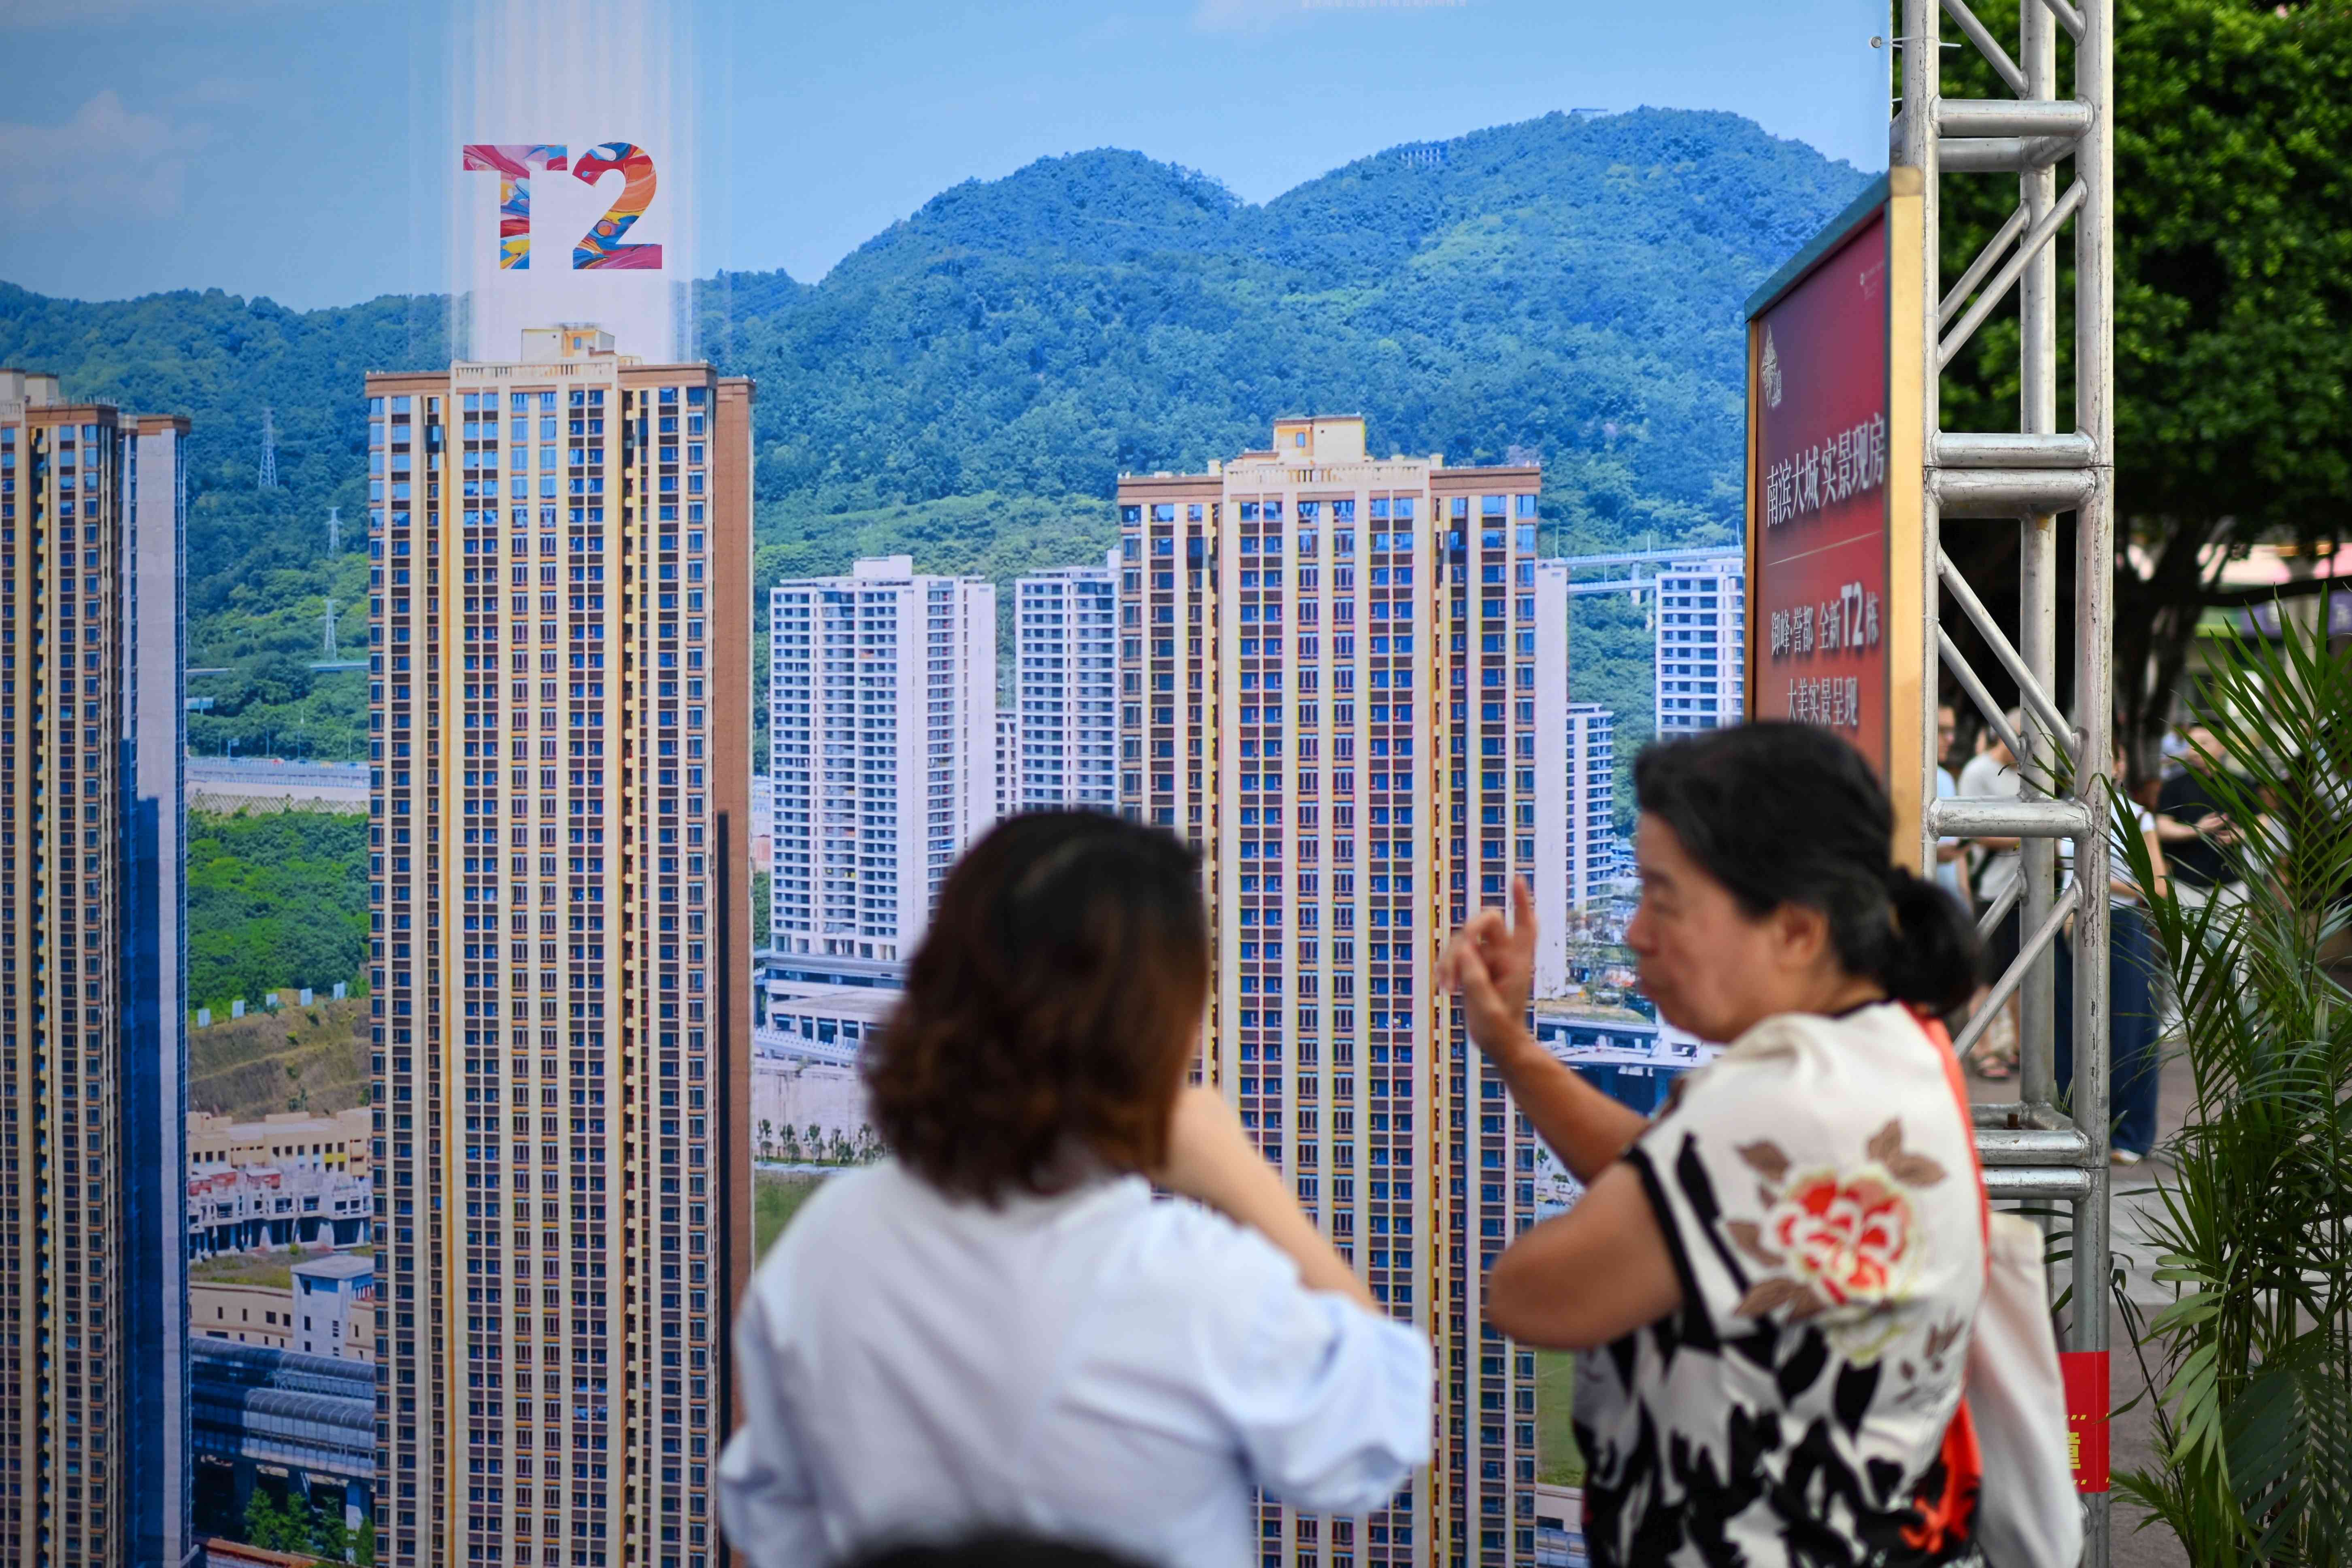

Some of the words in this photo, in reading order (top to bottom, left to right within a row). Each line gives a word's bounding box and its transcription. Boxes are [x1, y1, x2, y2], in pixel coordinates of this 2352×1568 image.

[463, 142, 662, 269] T2
[1767, 445, 1819, 528] 南滨大城
[1822, 412, 1884, 507] 实景现房
[1787, 677, 1857, 725] 大美实景呈现
